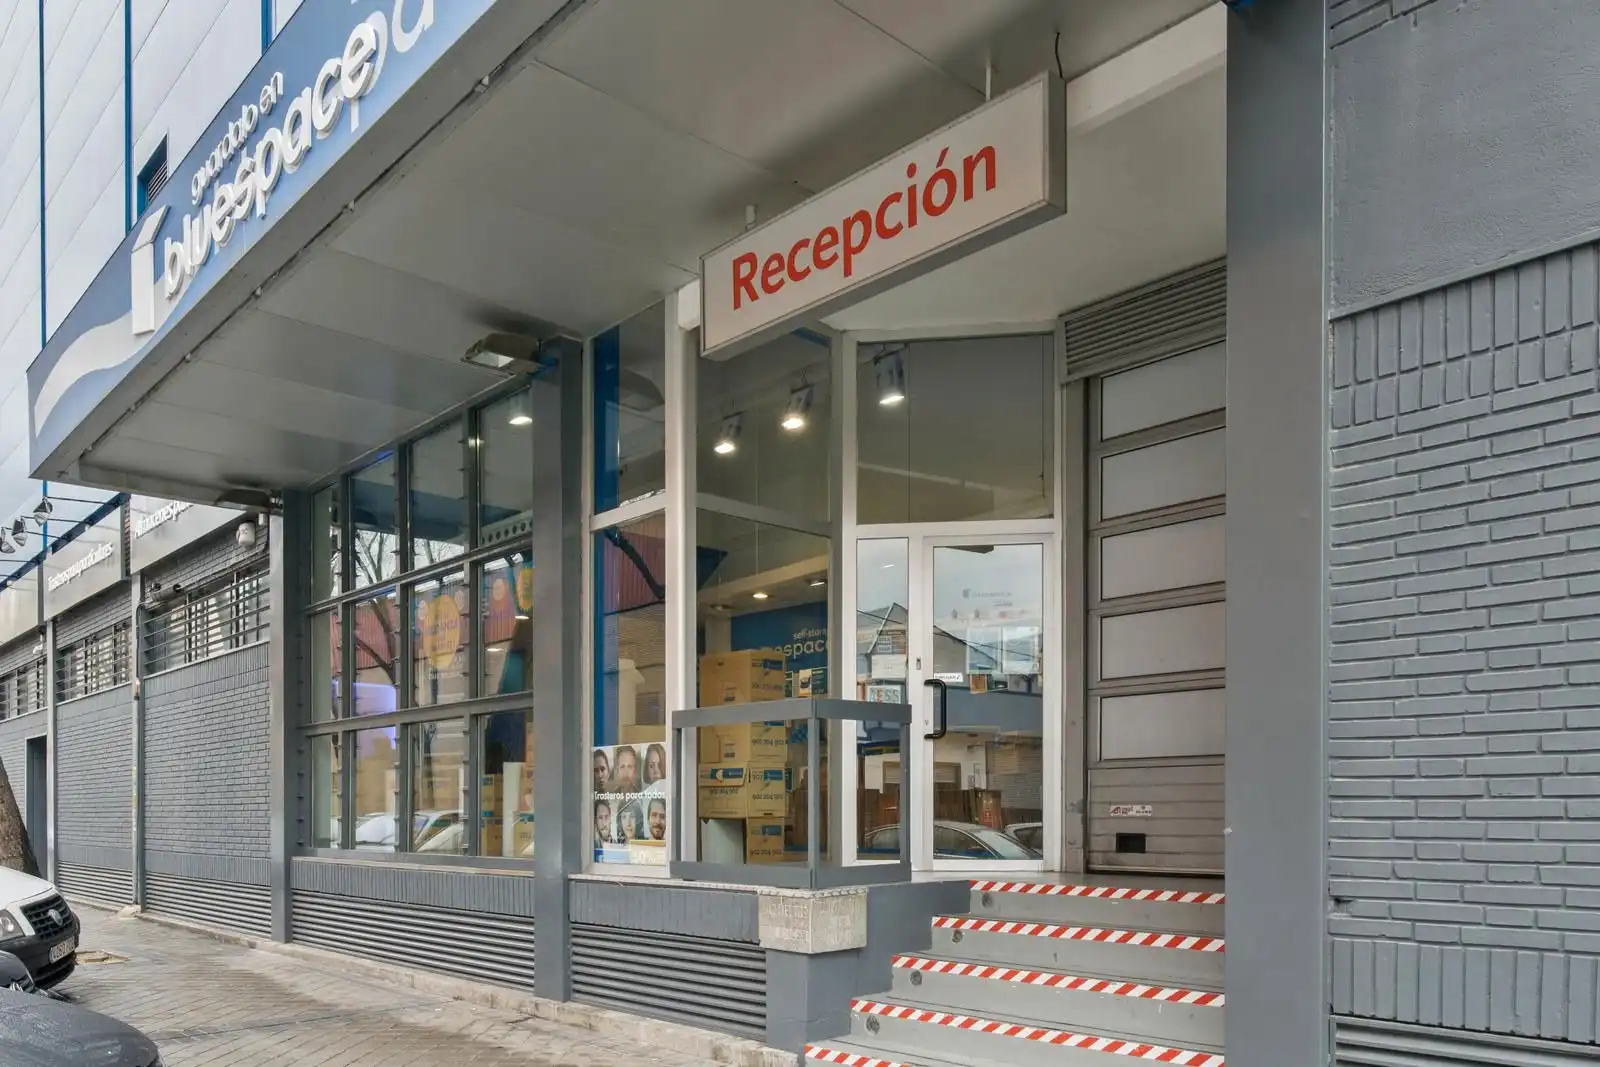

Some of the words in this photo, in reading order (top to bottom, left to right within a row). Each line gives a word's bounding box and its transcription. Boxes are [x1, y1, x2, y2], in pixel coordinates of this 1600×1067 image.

[164, 22, 377, 300] bluespace
[259, 71, 284, 116] en
[732, 144, 996, 311] Recepción
